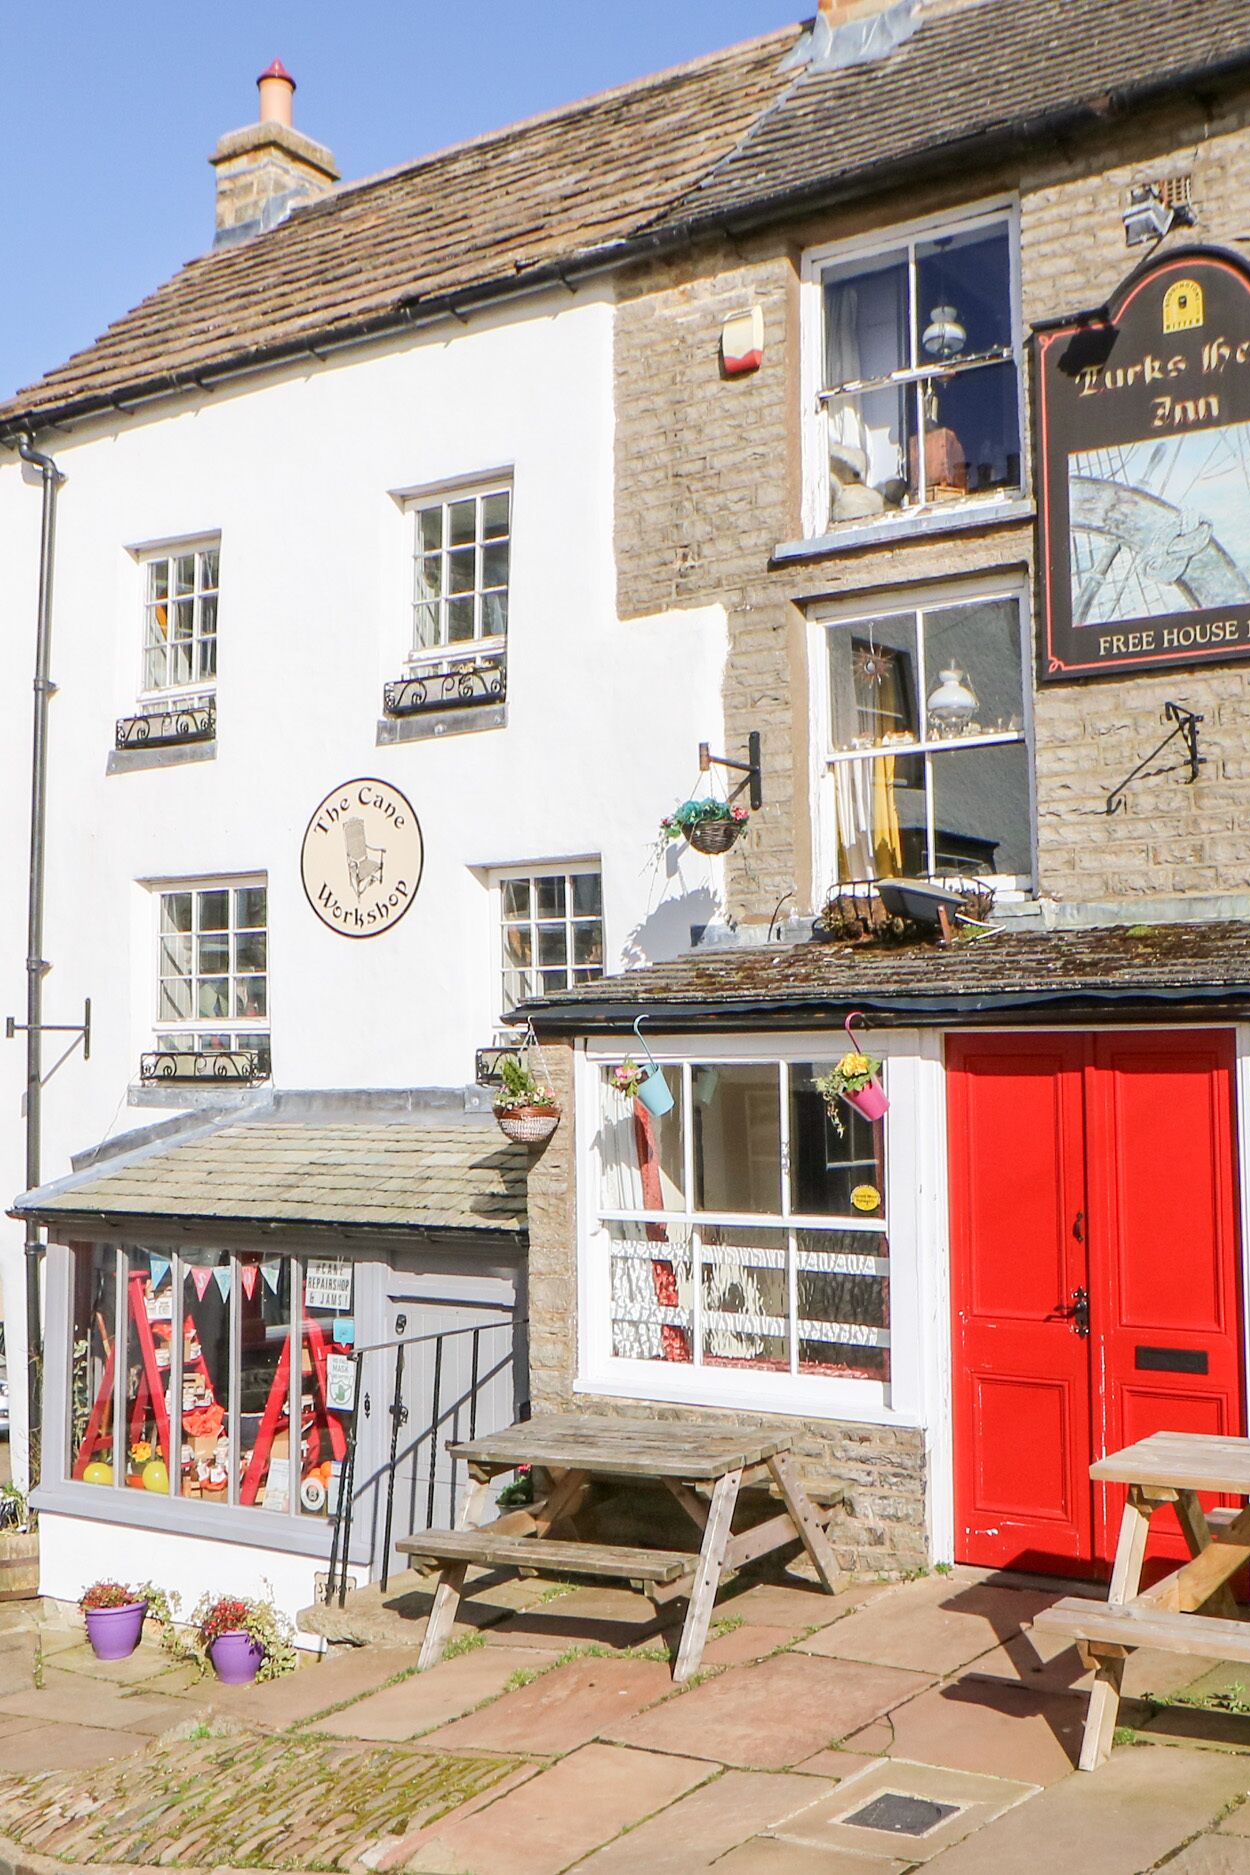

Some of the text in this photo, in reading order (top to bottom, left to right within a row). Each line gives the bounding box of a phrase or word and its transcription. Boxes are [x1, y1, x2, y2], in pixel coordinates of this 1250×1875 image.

[1075, 354, 1186, 397] Turks
[1151, 394, 1220, 427] Inn
[1099, 631, 1155, 655] FREE
[1163, 621, 1239, 646] HOUSE
[313, 786, 405, 835] The Cane
[318, 880, 409, 928] Workshop
